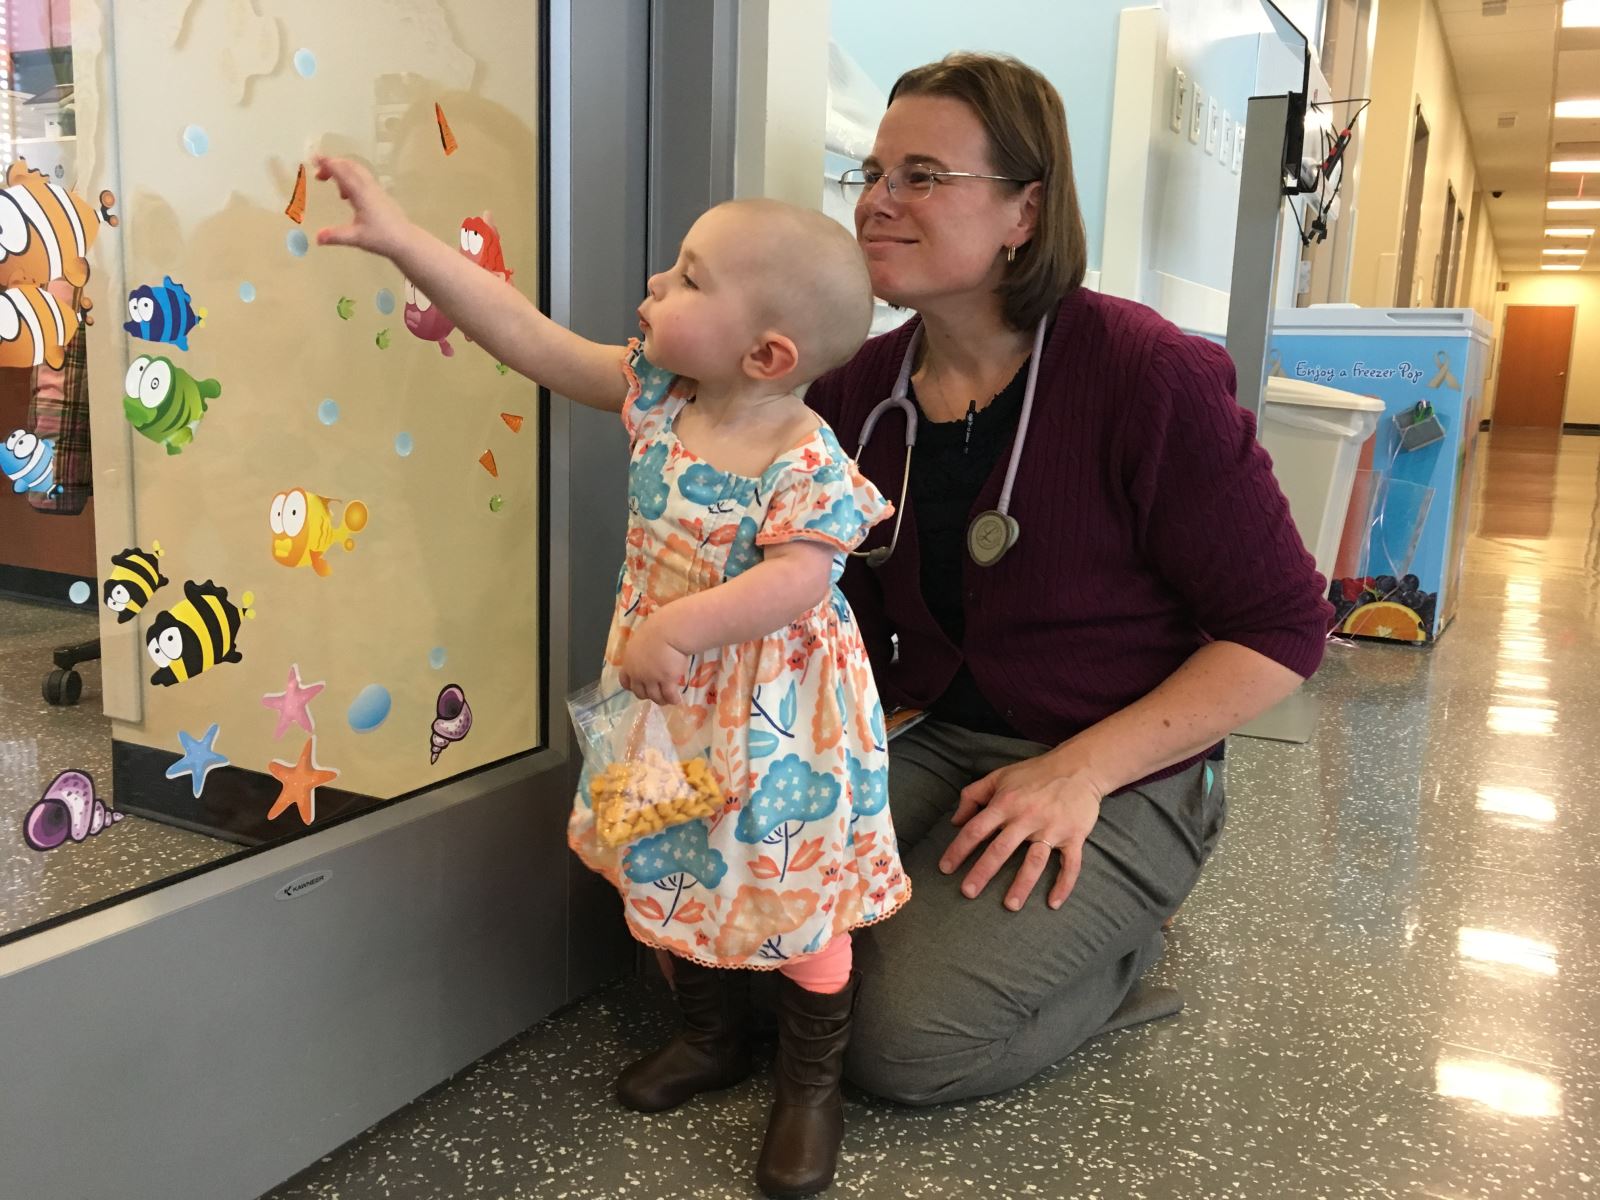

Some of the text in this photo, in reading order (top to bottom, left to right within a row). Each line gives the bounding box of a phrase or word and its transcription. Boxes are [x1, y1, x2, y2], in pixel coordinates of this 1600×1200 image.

[1295, 360, 1335, 382] Enjoy
[1339, 368, 1347, 377] a
[1398, 361, 1423, 384] Pop
[292, 875, 324, 892] KAWNEER
